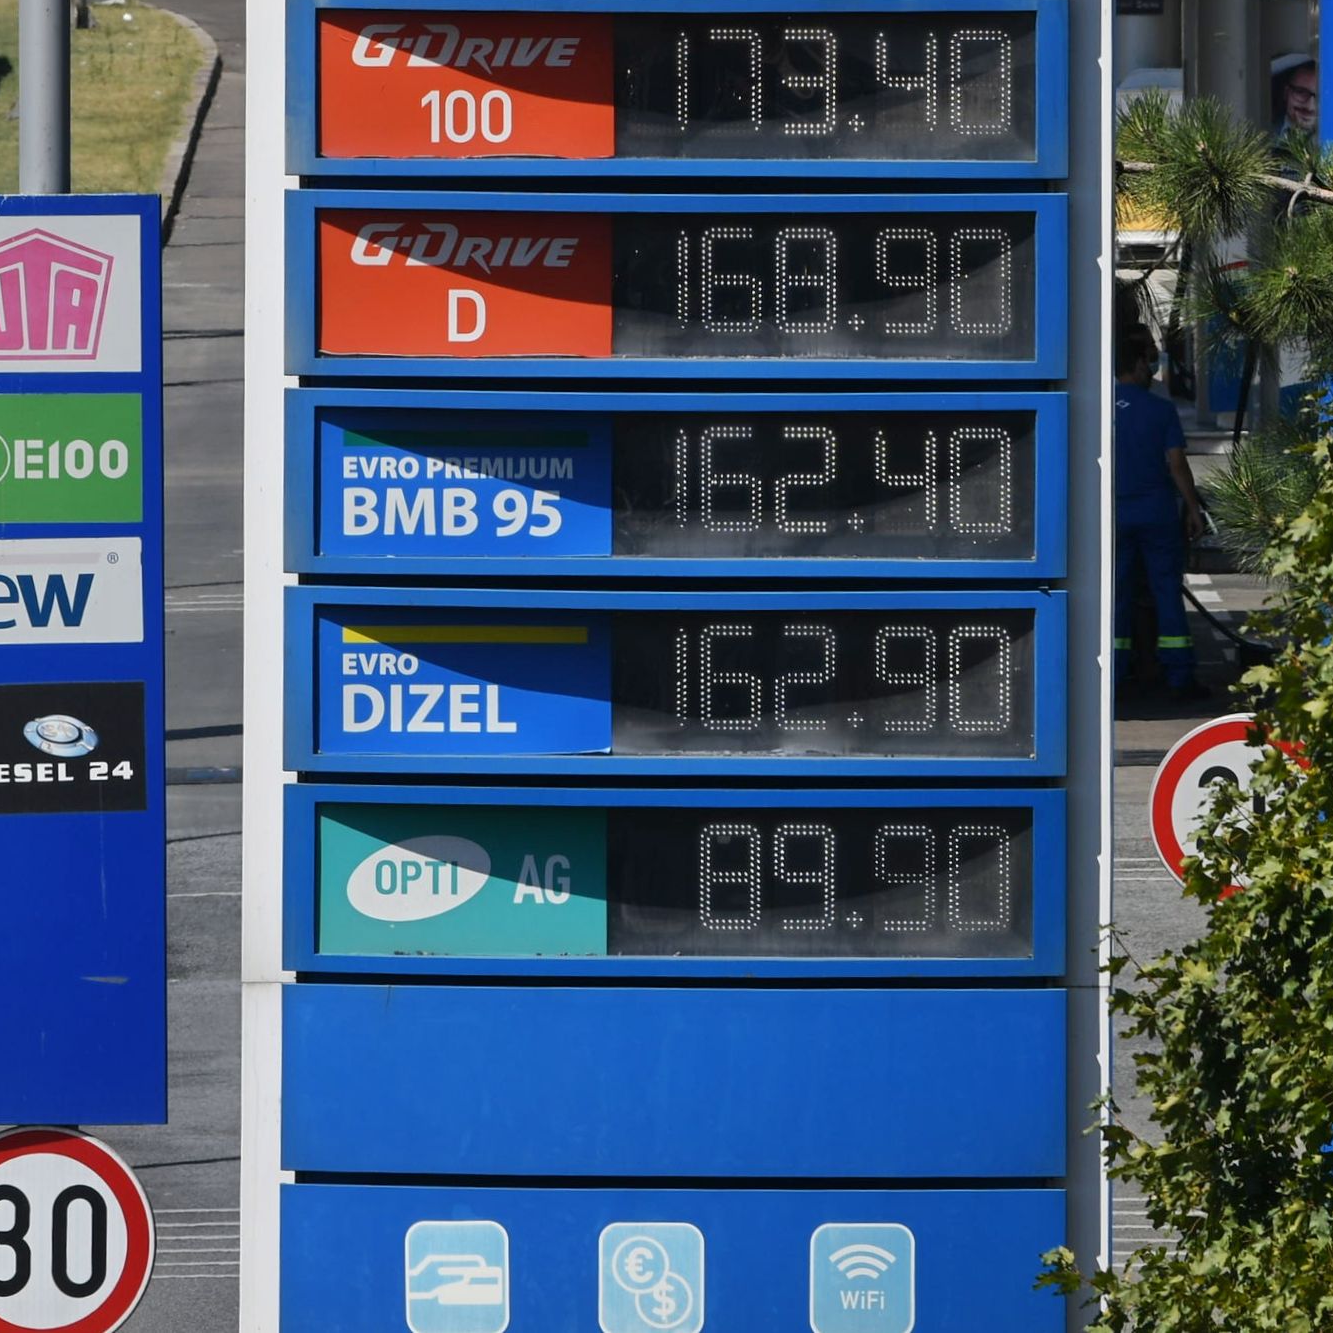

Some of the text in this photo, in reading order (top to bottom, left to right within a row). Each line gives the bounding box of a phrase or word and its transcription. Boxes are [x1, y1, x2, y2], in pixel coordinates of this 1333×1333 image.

[420, 28, 1012, 143] 100 173.40
[447, 227, 1012, 342] D 168.90
[14, 439, 129, 480] E100
[342, 457, 574, 480] EVRO PREMIJUM
[675, 426, 1012, 534] 162.40
[342, 488, 563, 538] BMB 95
[342, 653, 419, 676] EVRO
[675, 624, 1010, 732] 162.90
[342, 684, 518, 734] DIZEL
[88, 760, 135, 782] 24
[374, 854, 571, 905] OPTI AG
[699, 823, 1010, 932] 89.90
[839, 1289, 886, 1310] WiFi
